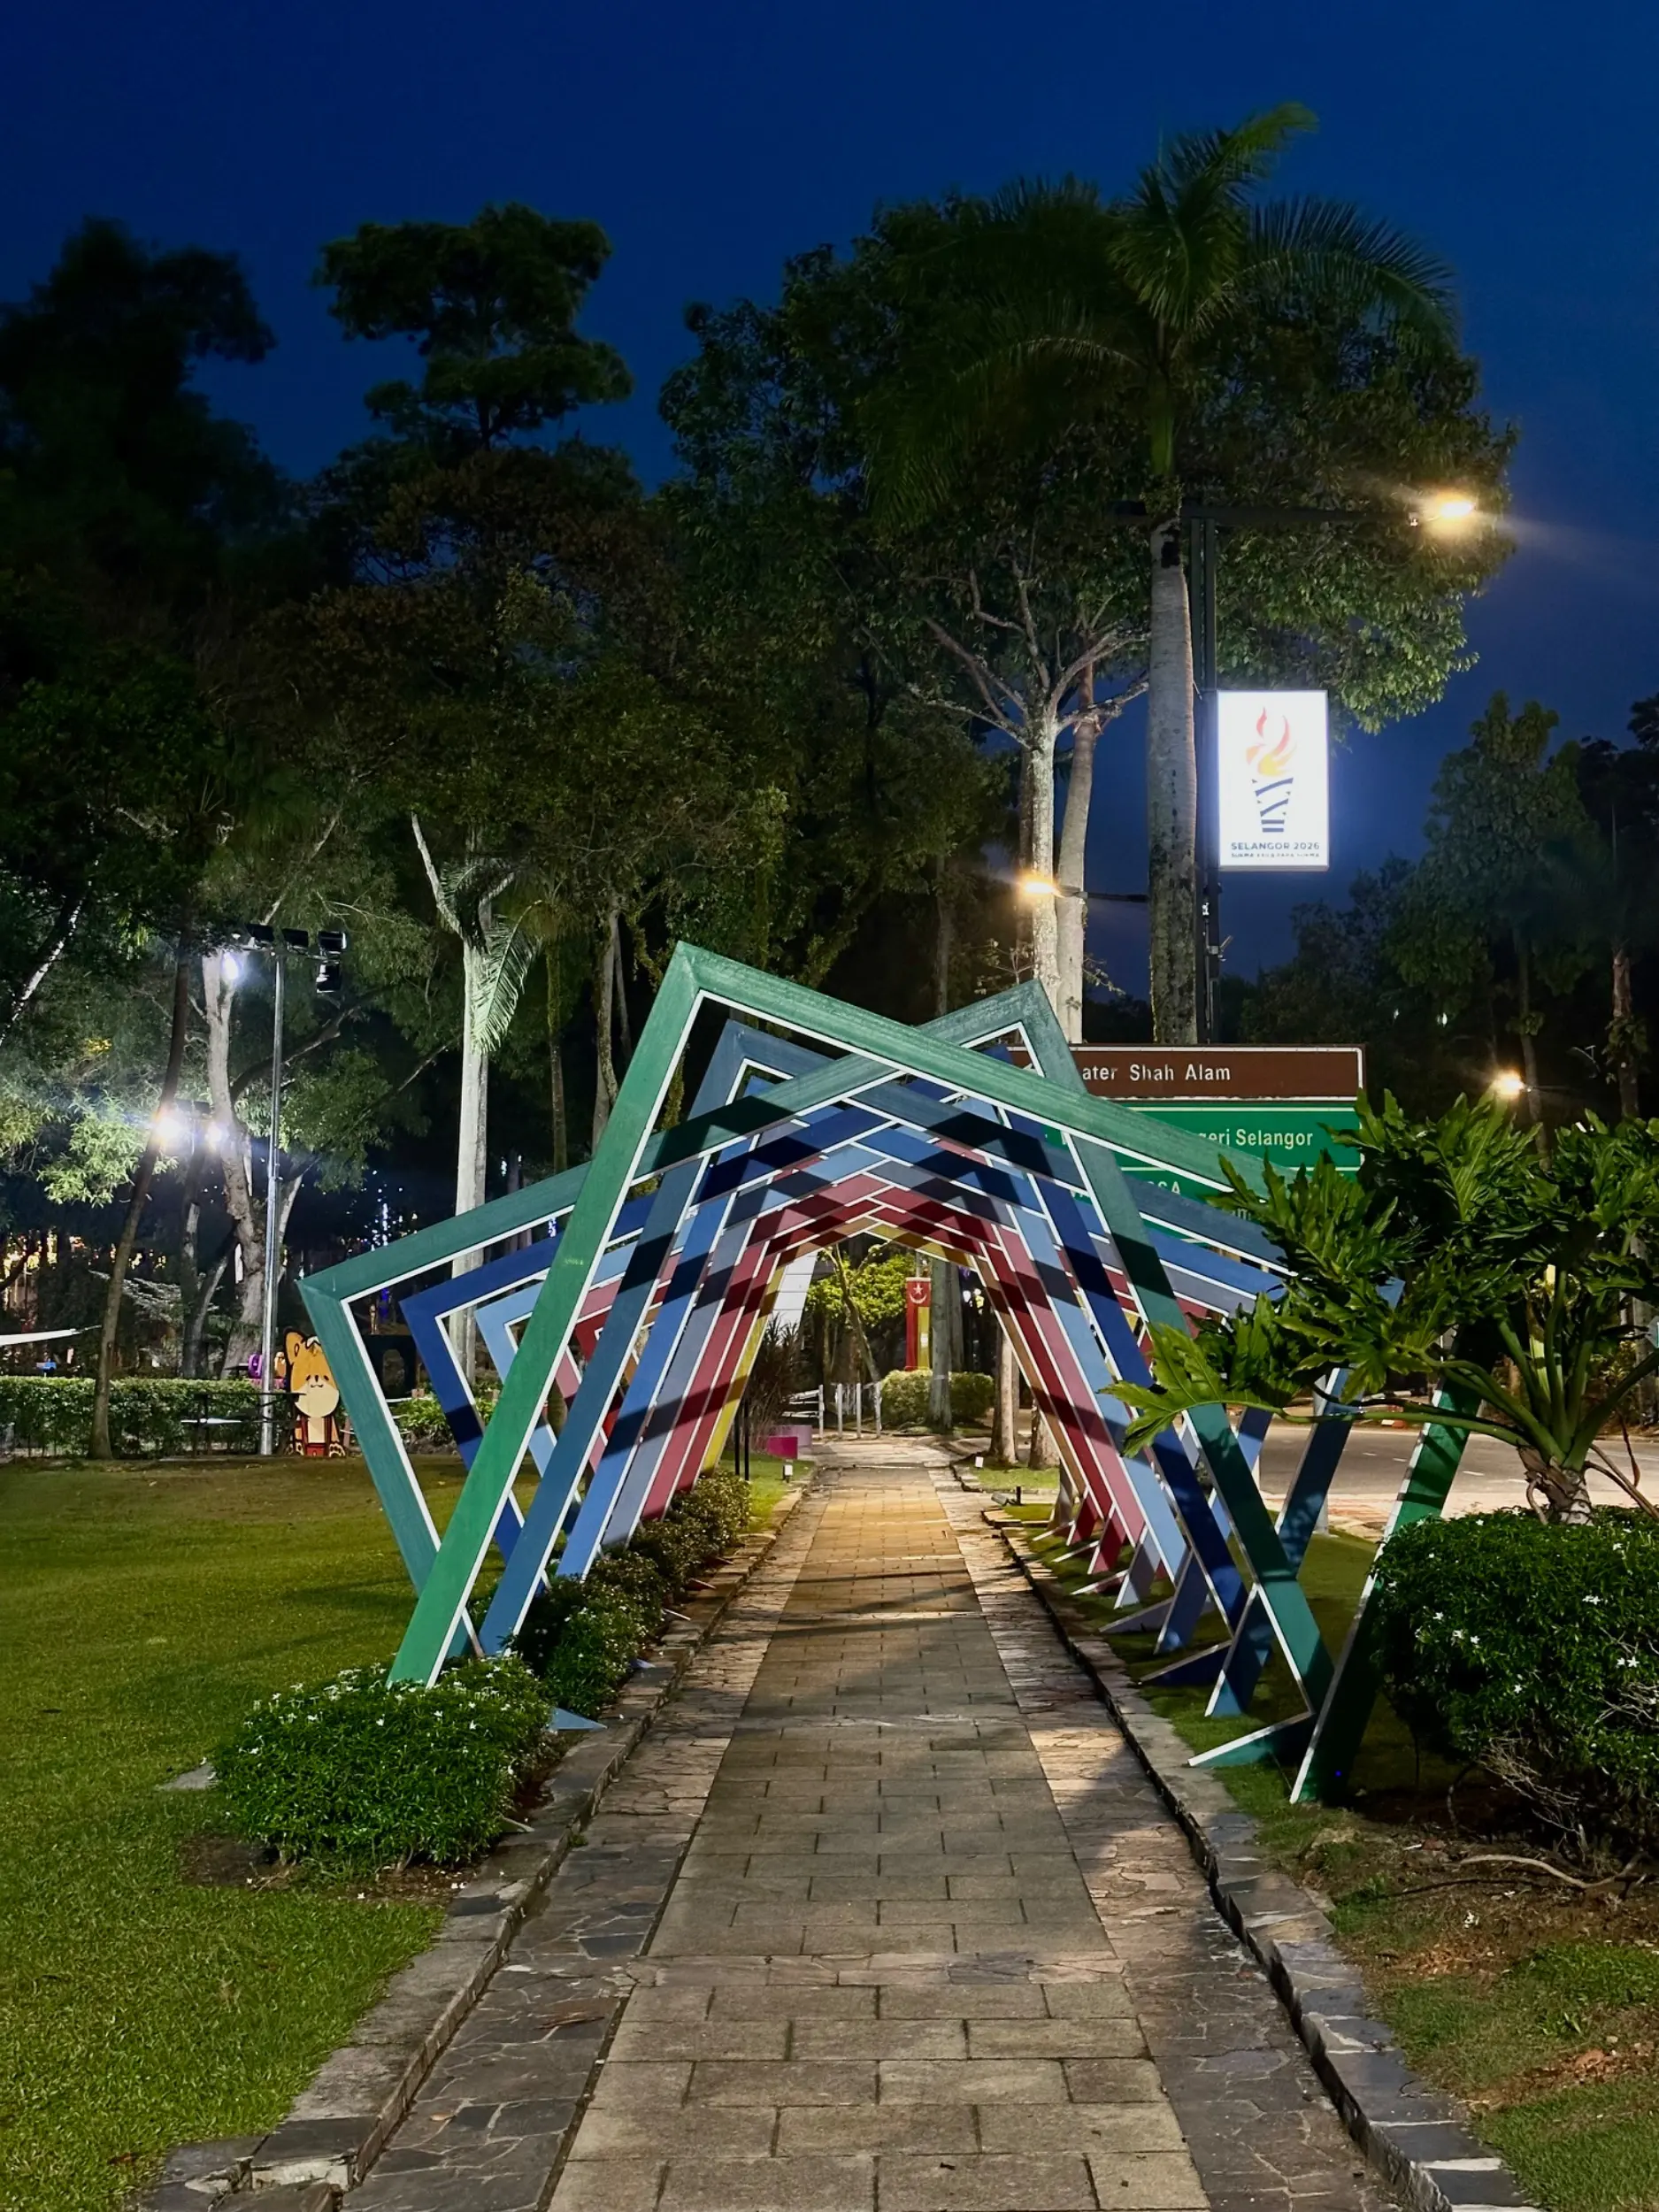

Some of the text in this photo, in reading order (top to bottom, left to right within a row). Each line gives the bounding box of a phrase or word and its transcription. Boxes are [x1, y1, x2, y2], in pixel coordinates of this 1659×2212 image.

[1081, 1064, 1231, 1081] ater Shah Alam
[1235, 1128, 1313, 1149] Selangor
